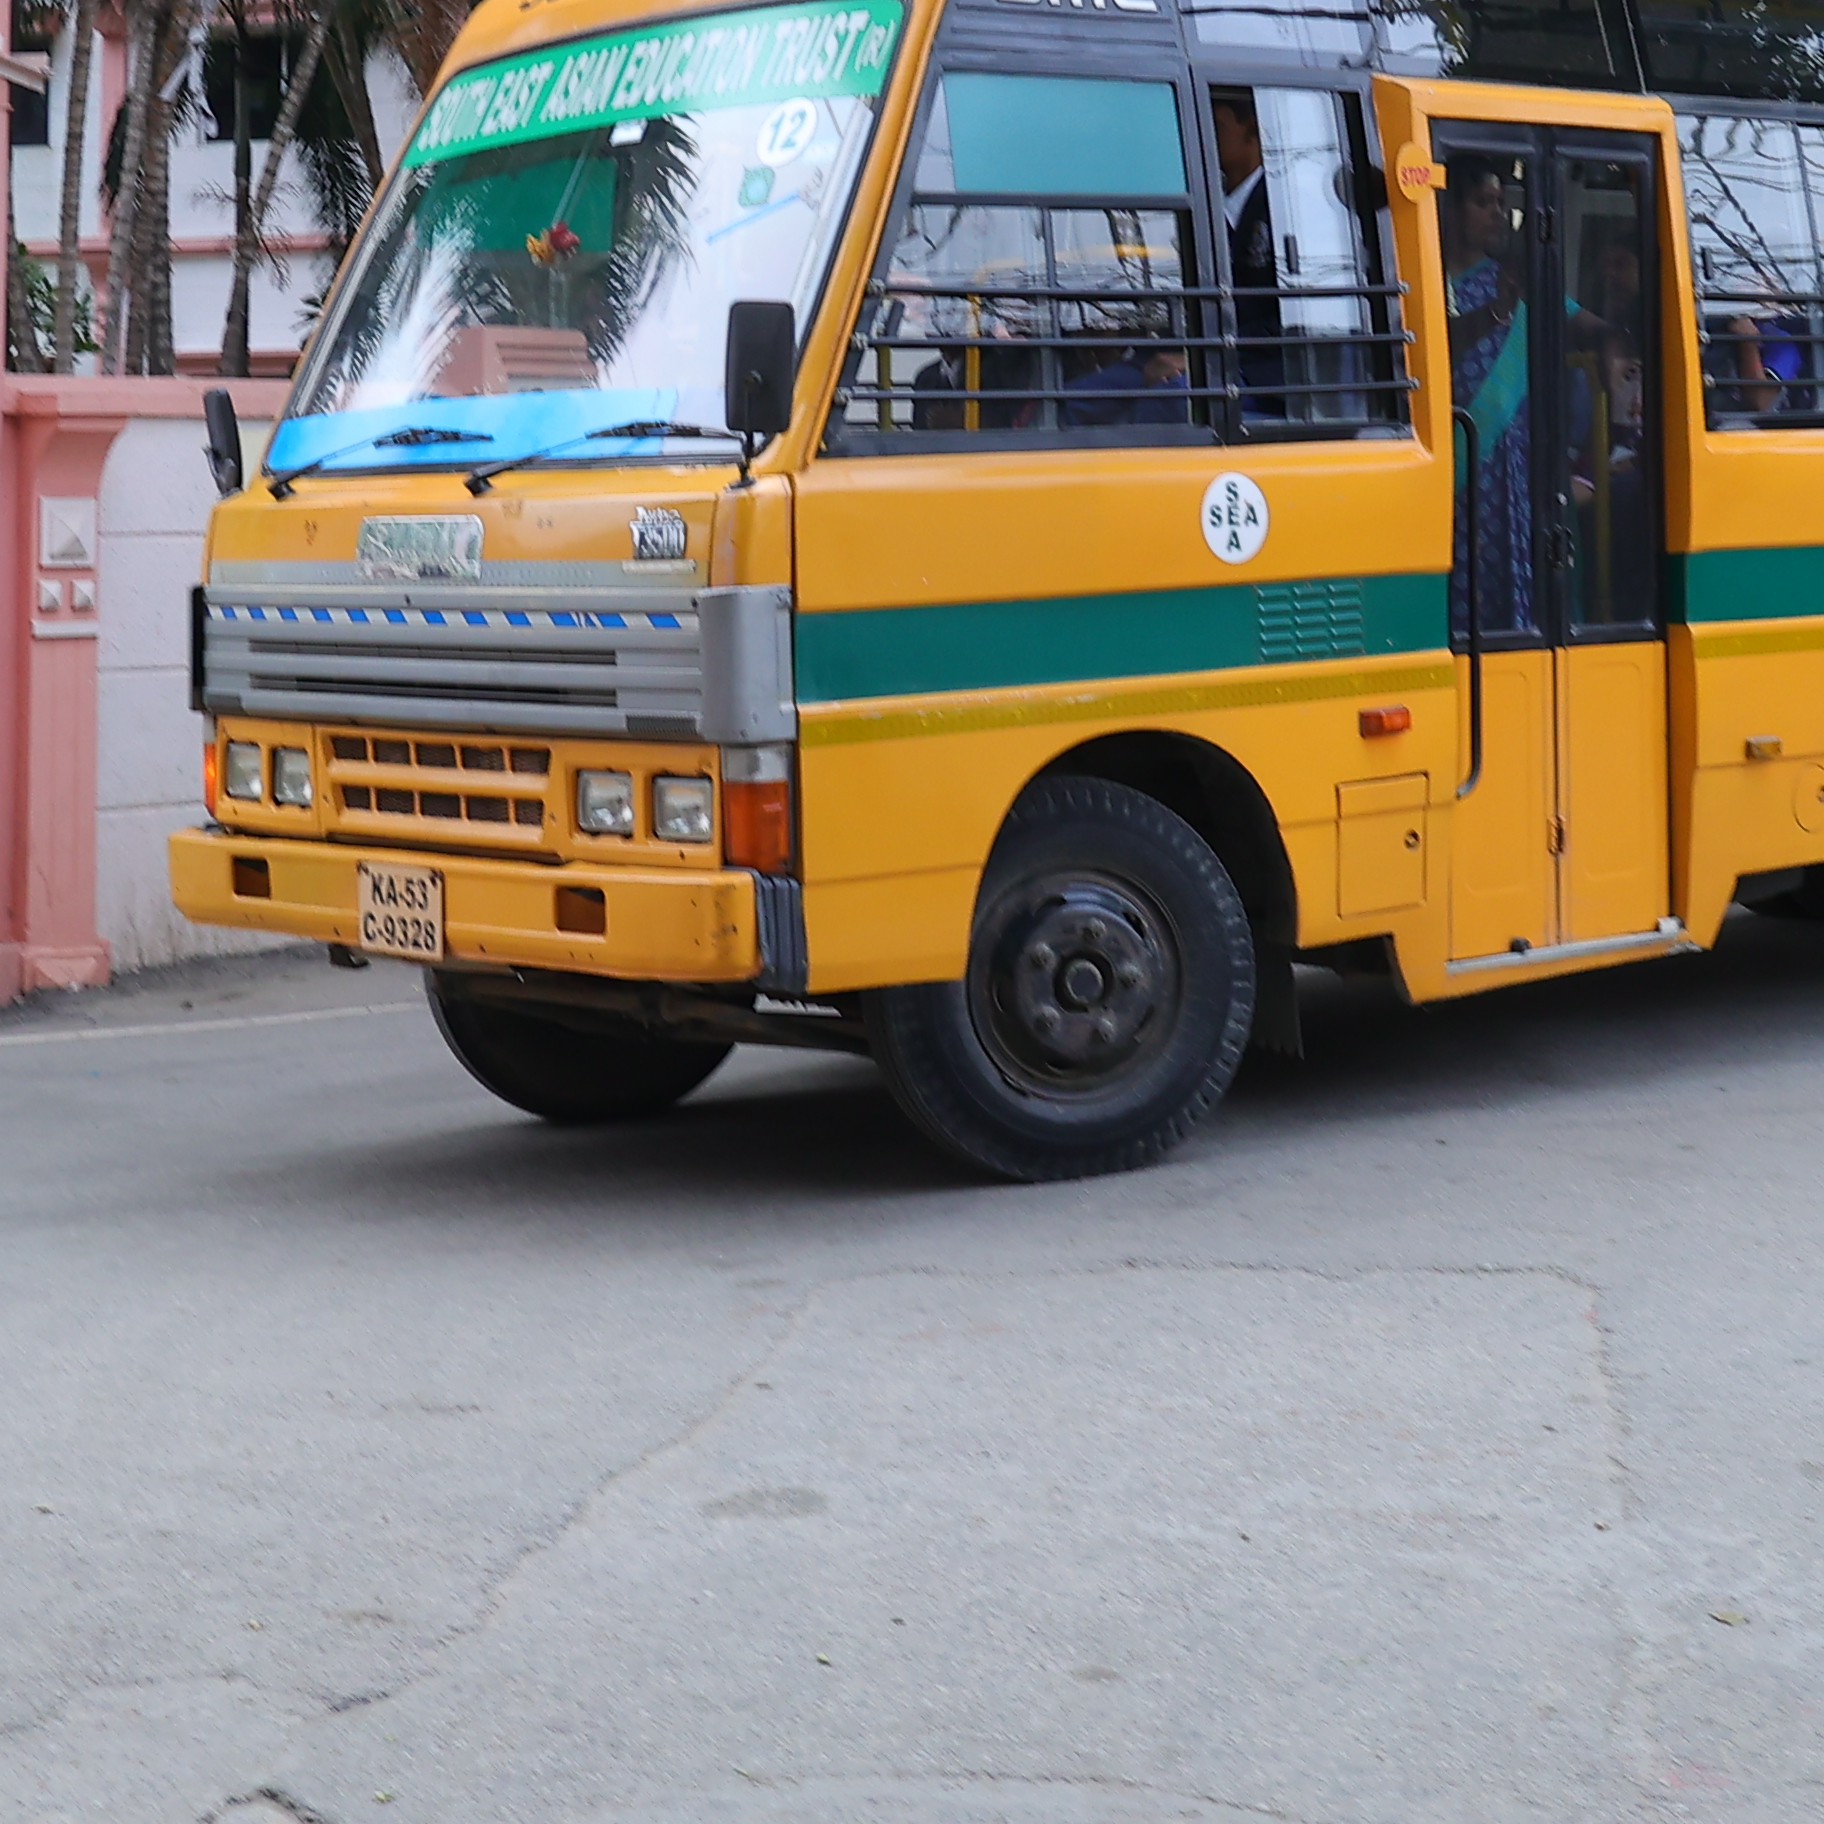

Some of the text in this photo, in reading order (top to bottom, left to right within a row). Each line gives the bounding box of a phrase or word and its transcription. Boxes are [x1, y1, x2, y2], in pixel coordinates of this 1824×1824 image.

[417, 76, 498, 152] SOUTH
[480, 60, 555, 137] EAST
[539, 43, 629, 123] ASIAN
[611, 22, 769, 110] EDUCATION
[761, 10, 870, 88] TRUST
[768, 108, 807, 153] 12
[1402, 167, 1430, 186] STOP
[371, 873, 428, 911] KA-53
[363, 912, 436, 951] C-9328
